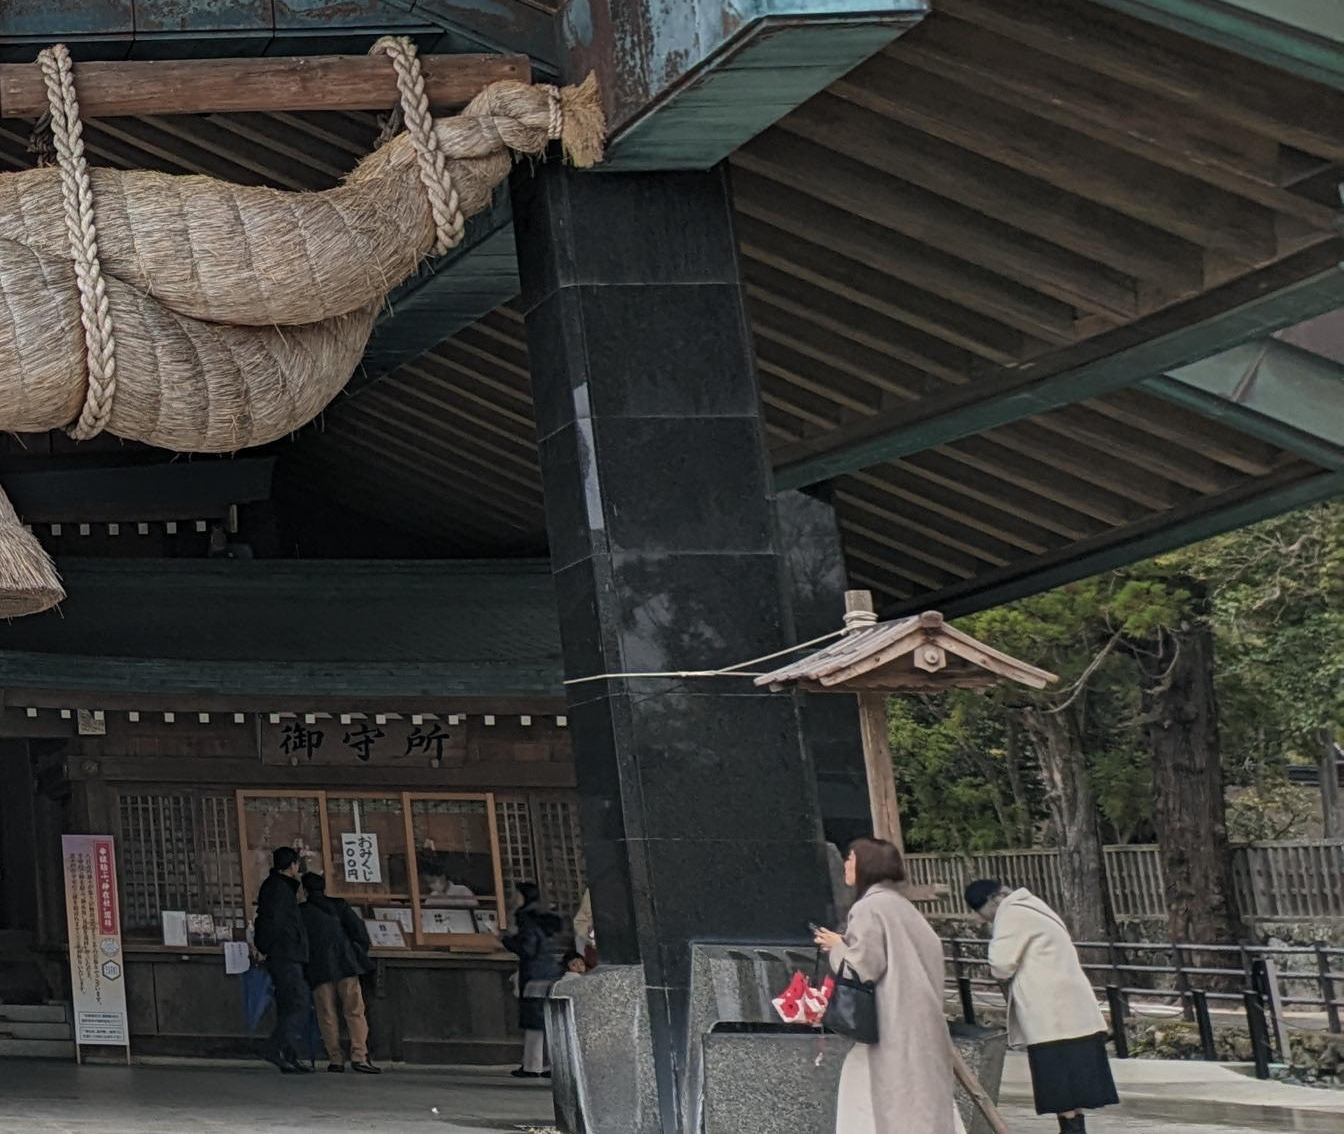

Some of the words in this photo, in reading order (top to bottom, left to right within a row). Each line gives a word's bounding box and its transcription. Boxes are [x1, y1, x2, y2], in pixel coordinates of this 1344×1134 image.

[279, 722, 450, 762] 御守所
[357, 835, 374, 882] おみくじ
